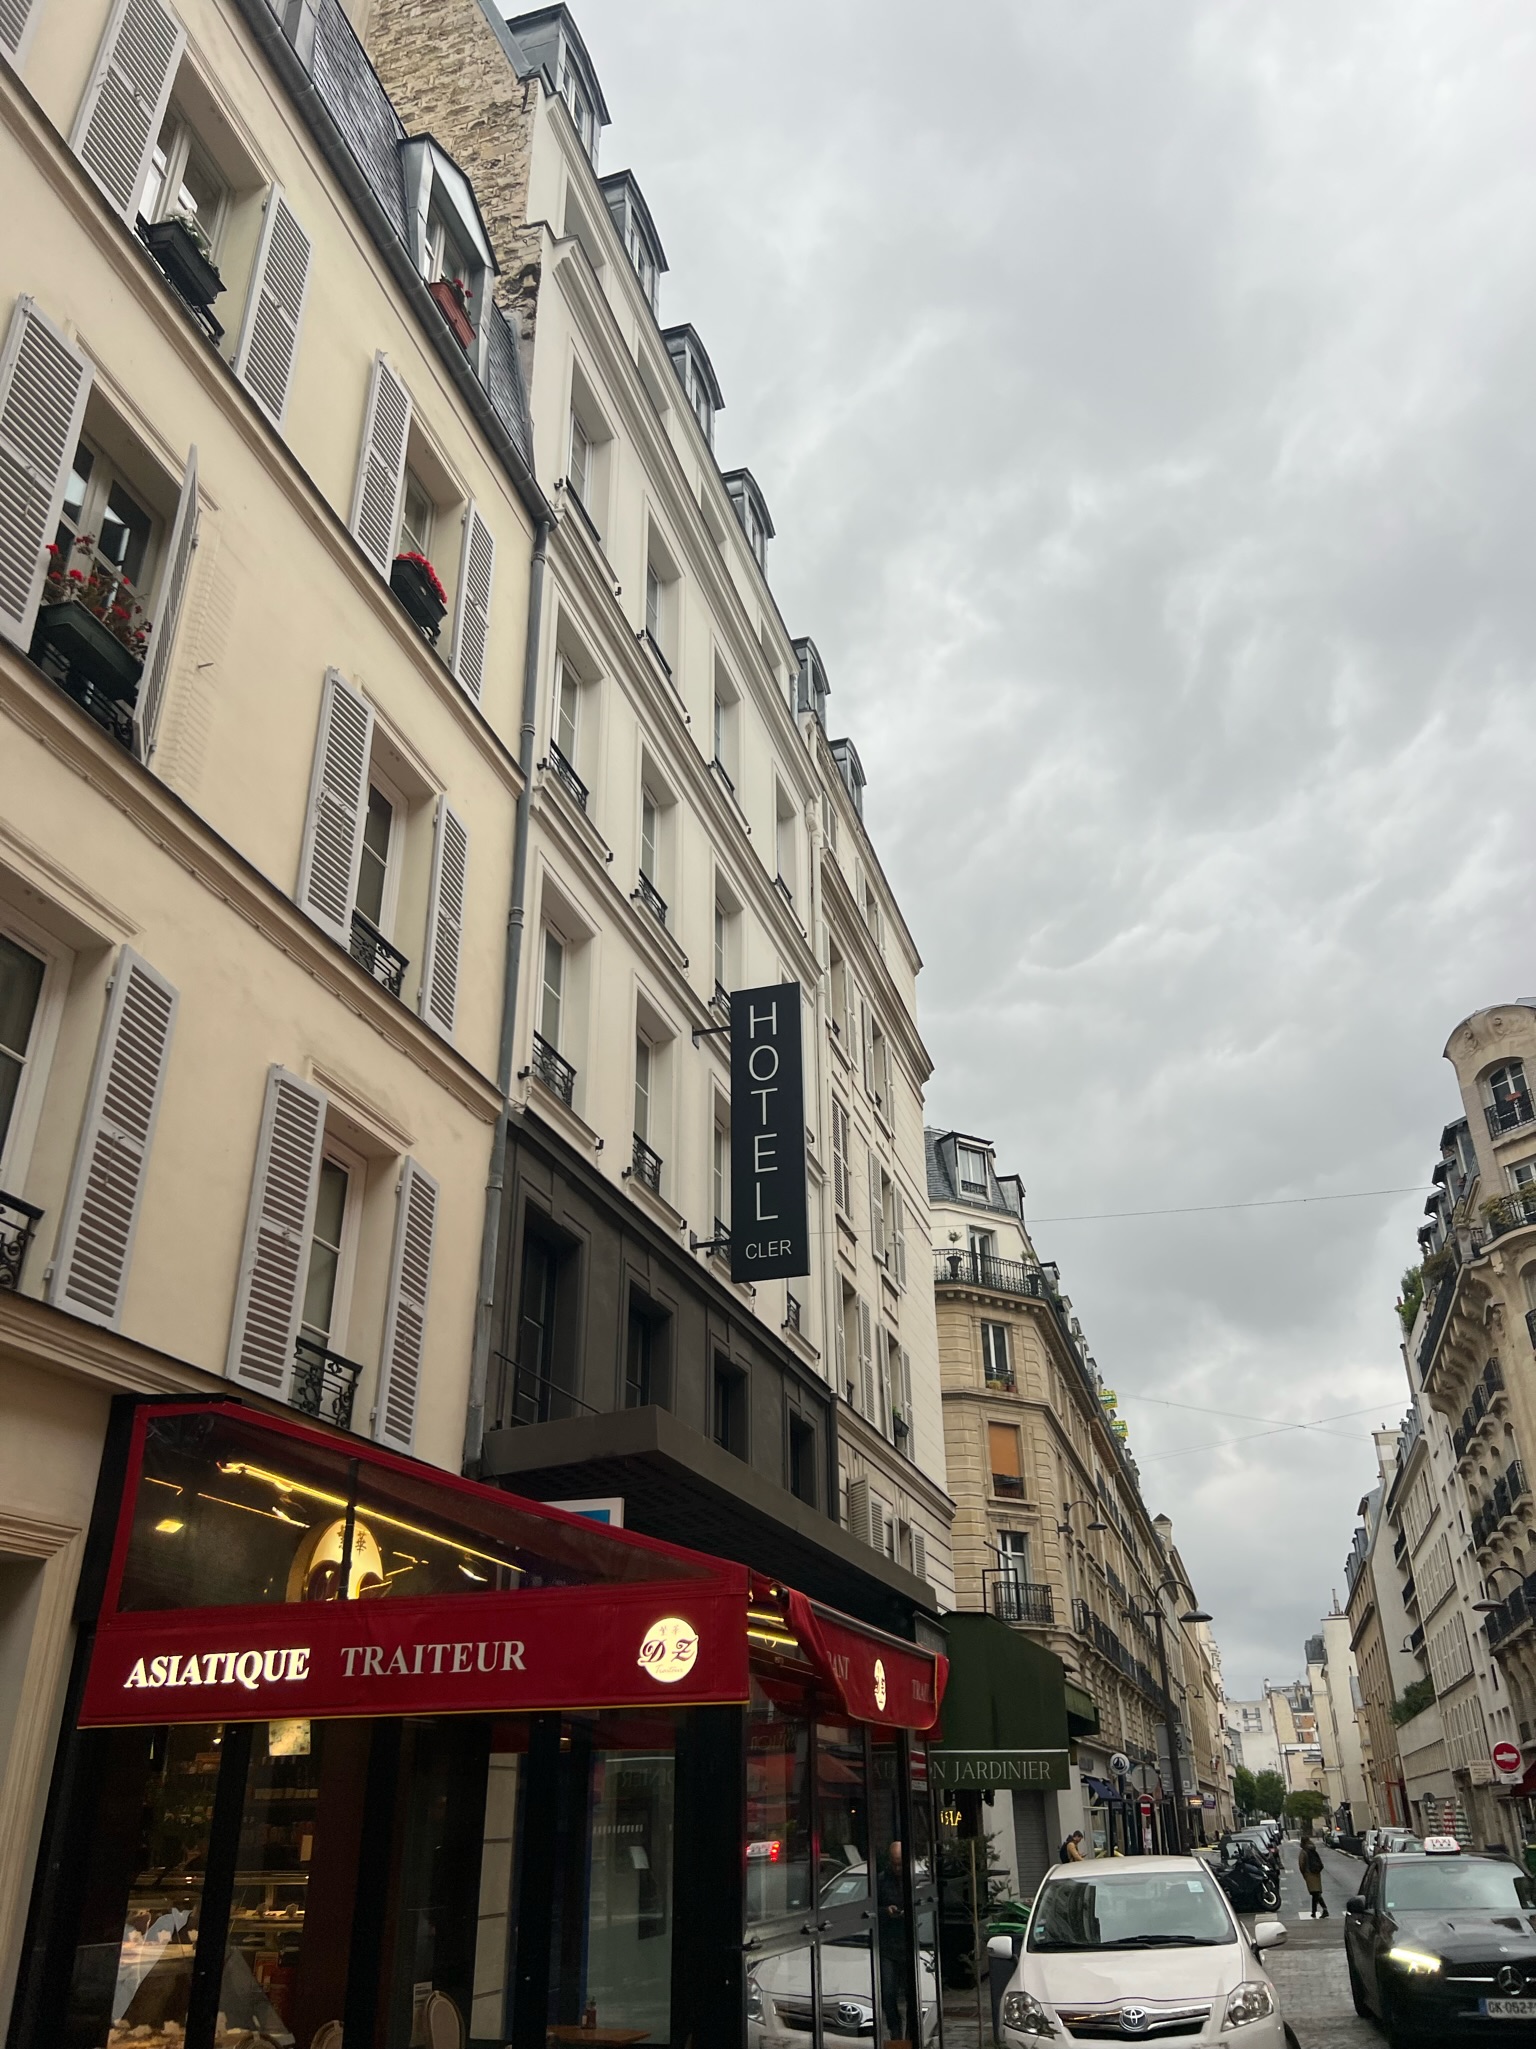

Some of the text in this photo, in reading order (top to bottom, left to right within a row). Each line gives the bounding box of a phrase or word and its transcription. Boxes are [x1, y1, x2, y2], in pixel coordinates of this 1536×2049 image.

[748, 1001, 780, 1222] HOTEL
[745, 1239, 792, 1260] CLER
[123, 1640, 527, 1690] ASIATIQUE TRAITEUR
[954, 1761, 1051, 1783] JARDINIER
